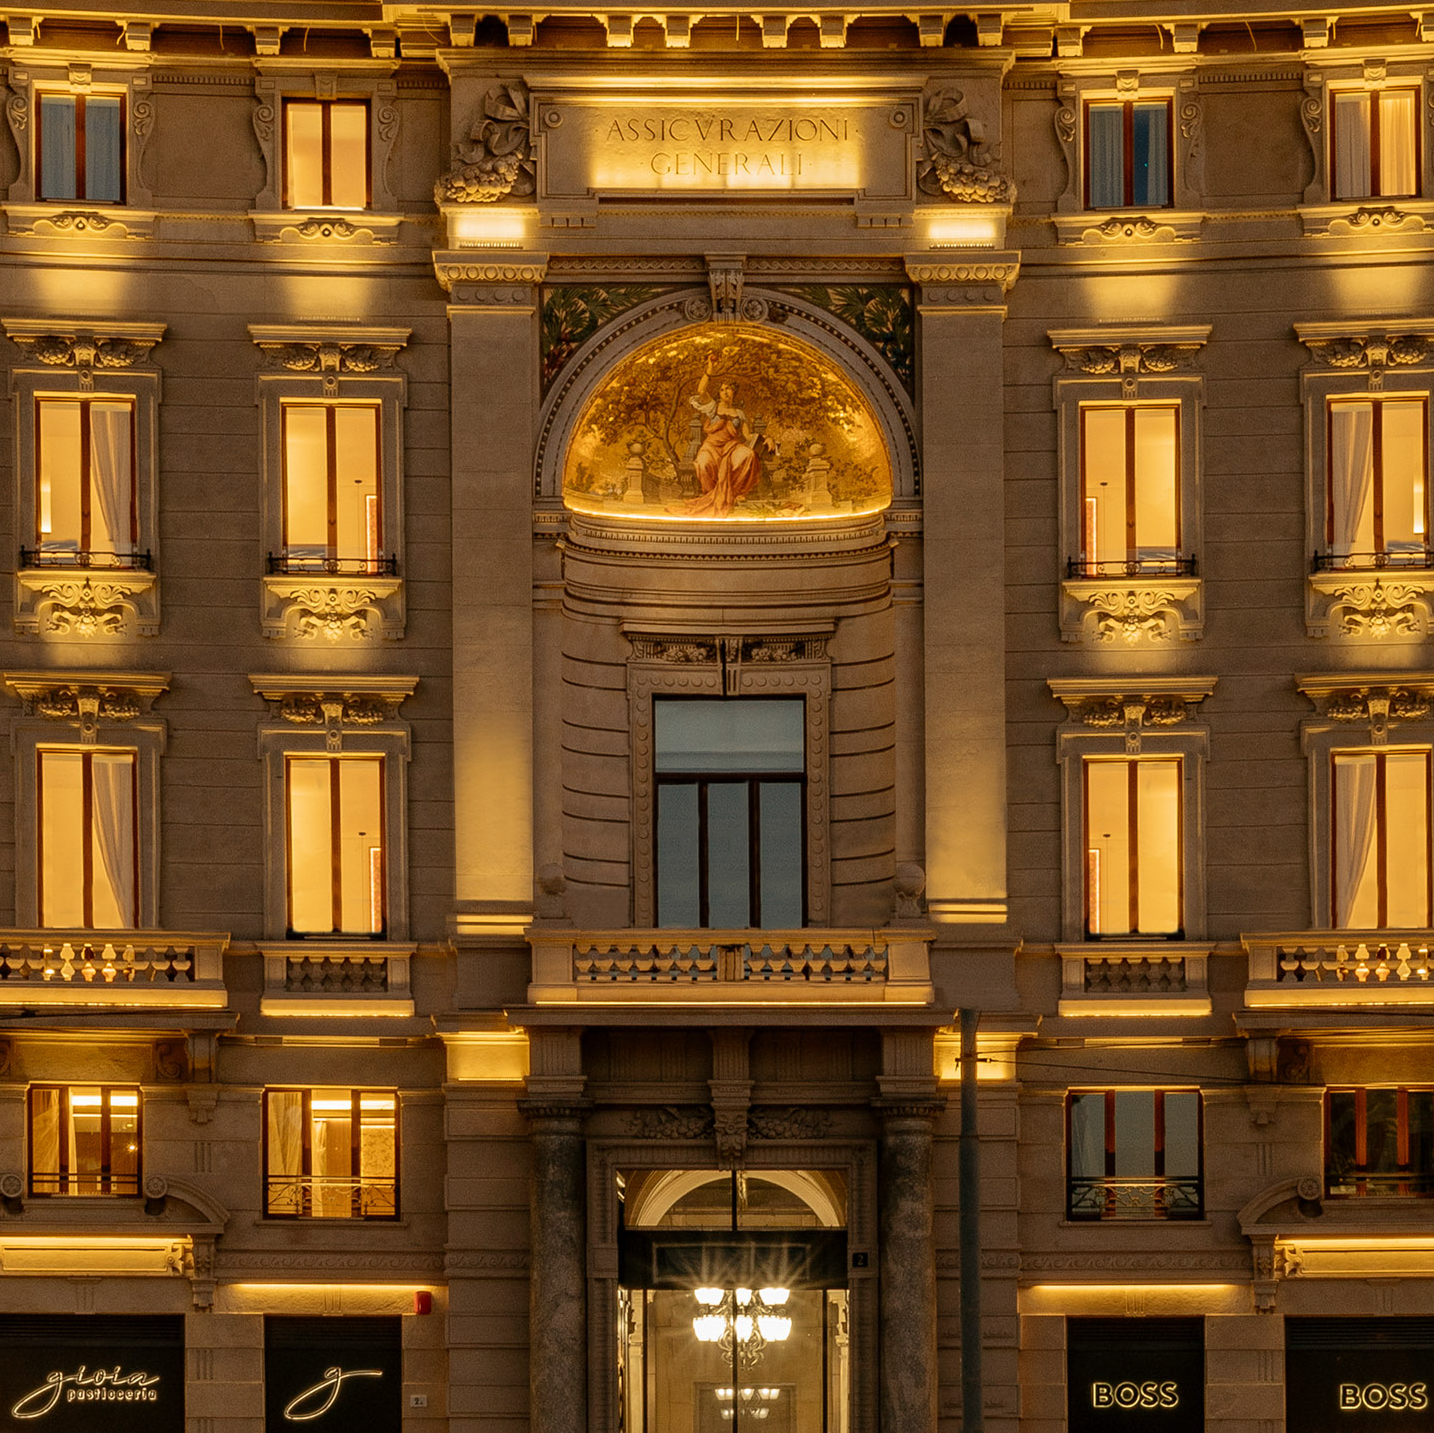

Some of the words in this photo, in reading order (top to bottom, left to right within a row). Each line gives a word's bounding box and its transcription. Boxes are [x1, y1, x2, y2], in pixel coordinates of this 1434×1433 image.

[650, 151, 803, 176] GENERALI
[857, 1254, 864, 1266] 2
[11, 1365, 160, 1419] gioia
[1092, 1381, 1179, 1409] BOSS
[1339, 1382, 1429, 1410] BOSS
